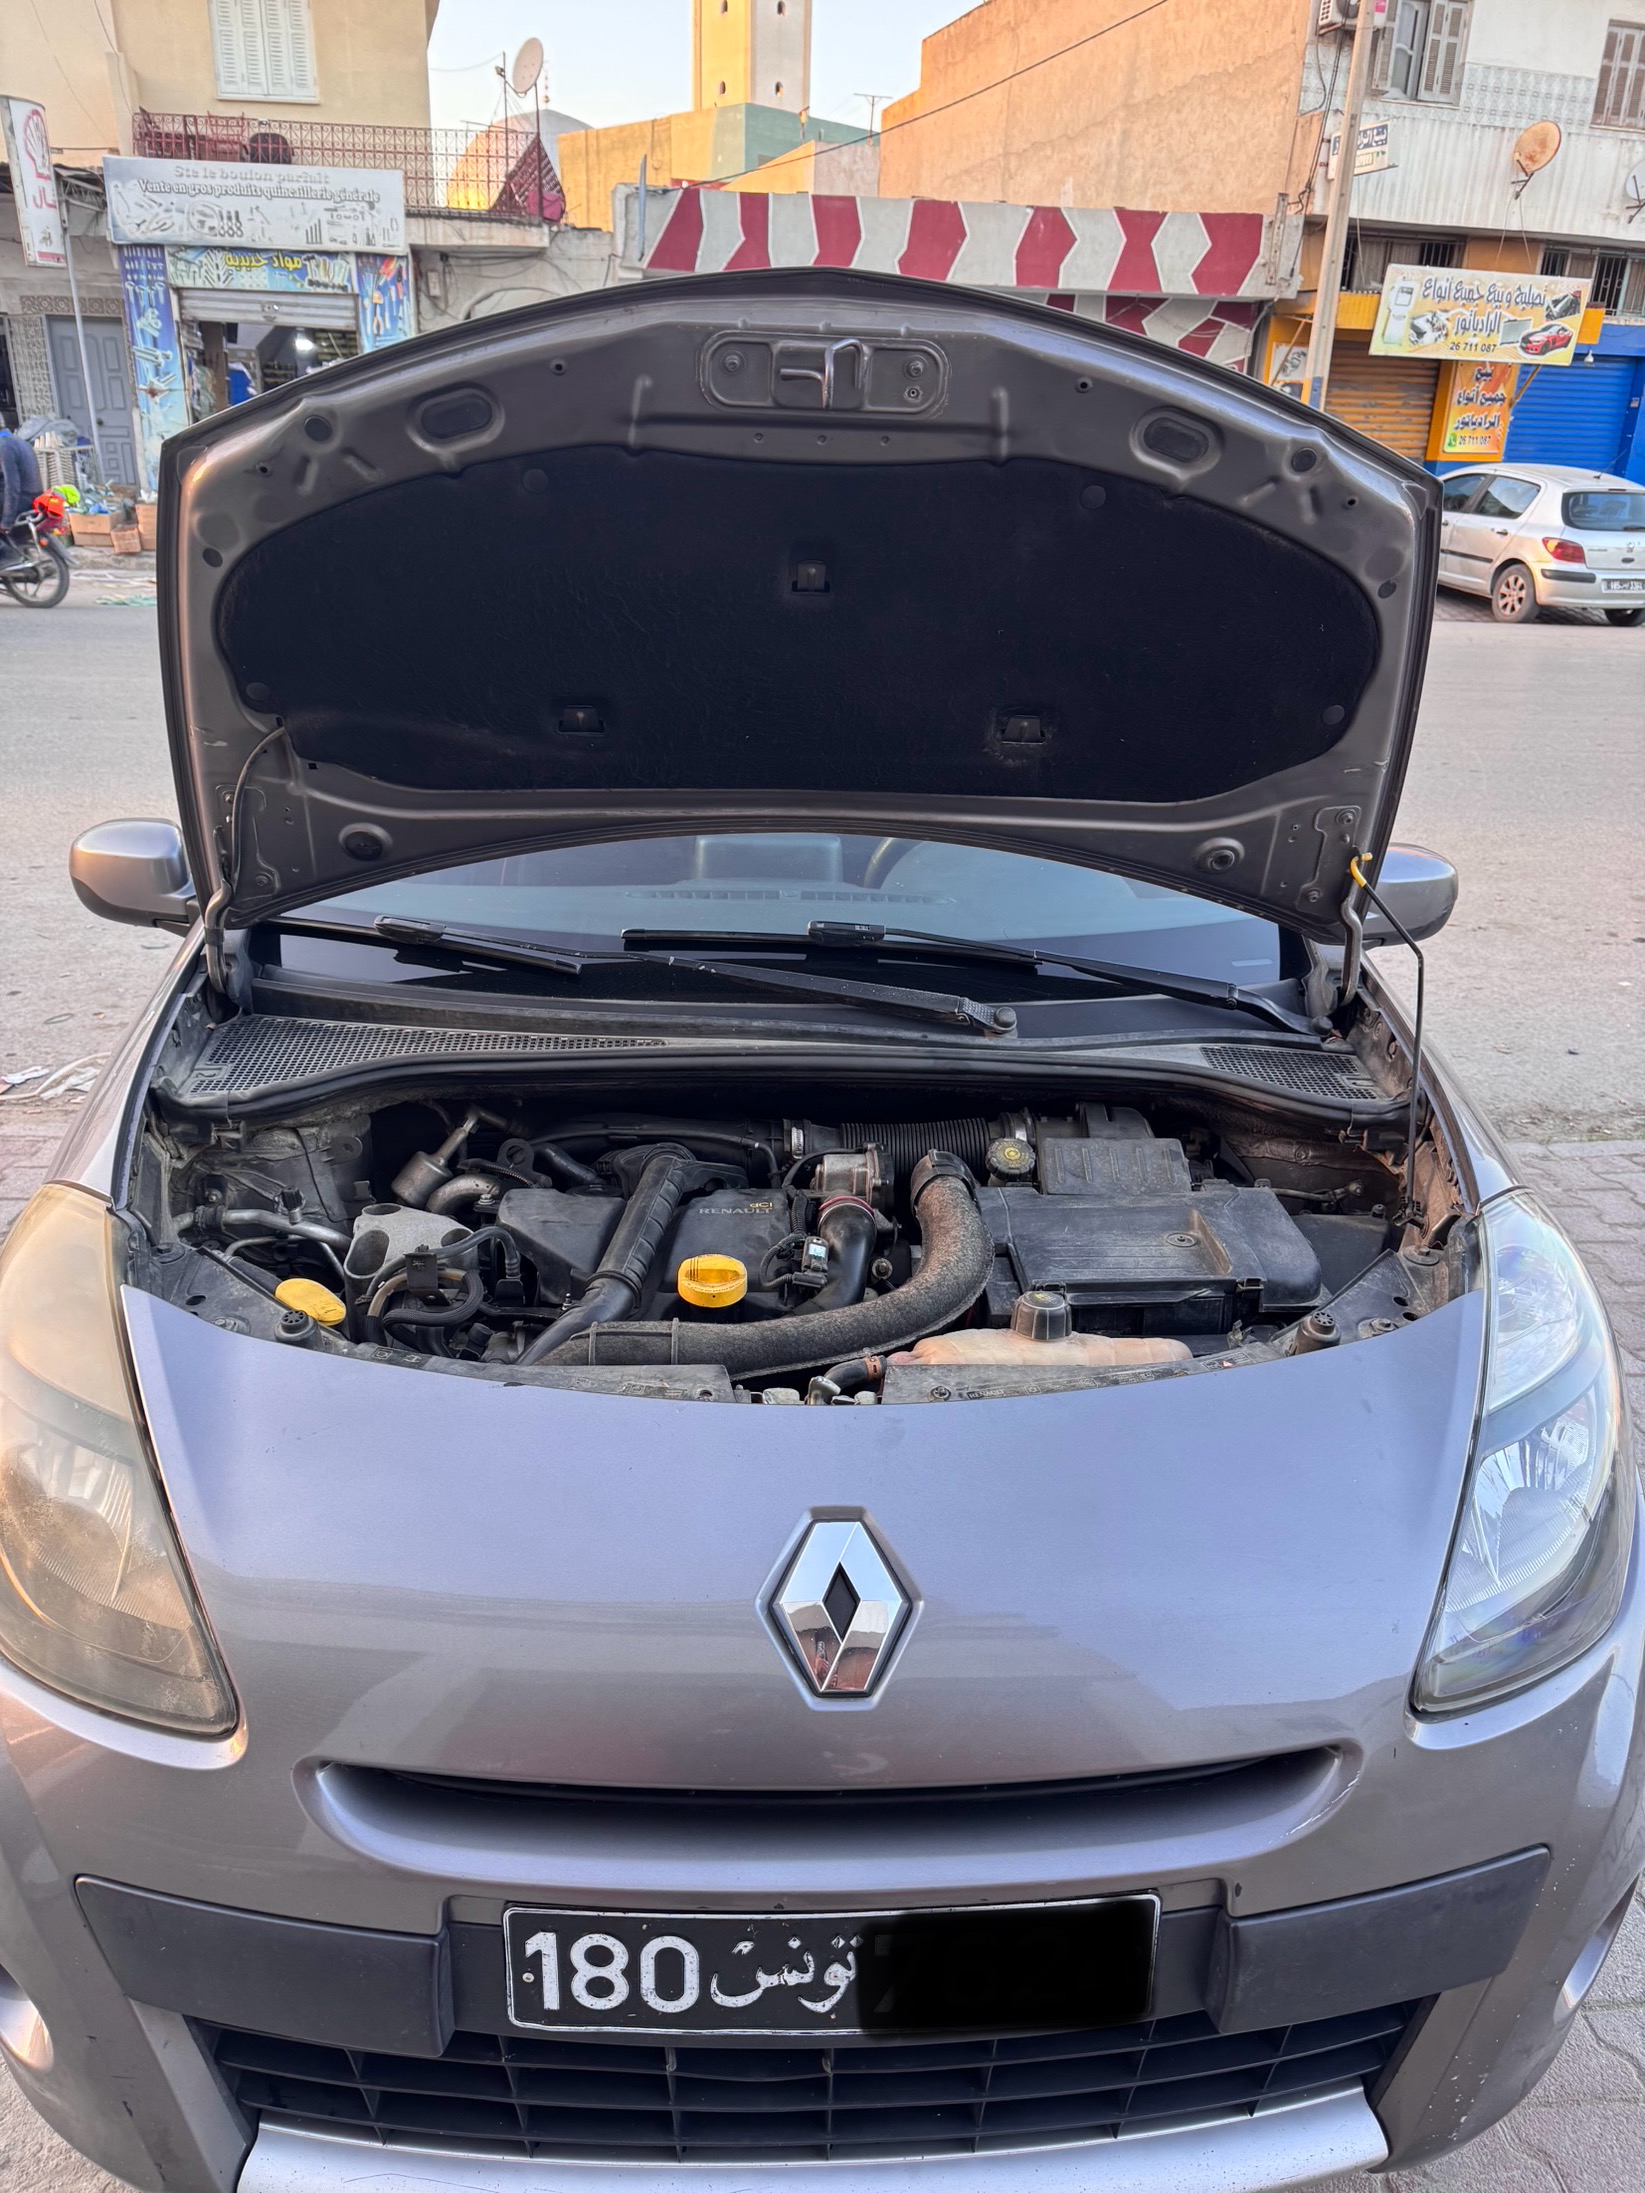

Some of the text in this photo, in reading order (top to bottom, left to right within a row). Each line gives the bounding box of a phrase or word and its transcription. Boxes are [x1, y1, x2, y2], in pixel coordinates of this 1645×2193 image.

[202, 169, 216, 179] le
[219, 169, 273, 182] boulon
[137, 178, 171, 193] Vente
[171, 183, 187, 193] en
[187, 183, 213, 197] gros
[213, 182, 262, 198] produits
[262, 184, 332, 201] quincaillerie
[271, 249, 302, 272] مواد
[1453, 280, 1484, 307] جميع
[1485, 282, 1505, 309] بيع
[1454, 309, 1501, 336] الرادياتور
[1449, 341, 1497, 352] 26 711 087
[1480, 392, 1506, 407] جميع
[699, 1207, 772, 1215] RENAULT
[524, 1930, 700, 2014] 180
[711, 1932, 864, 2013] تونس
